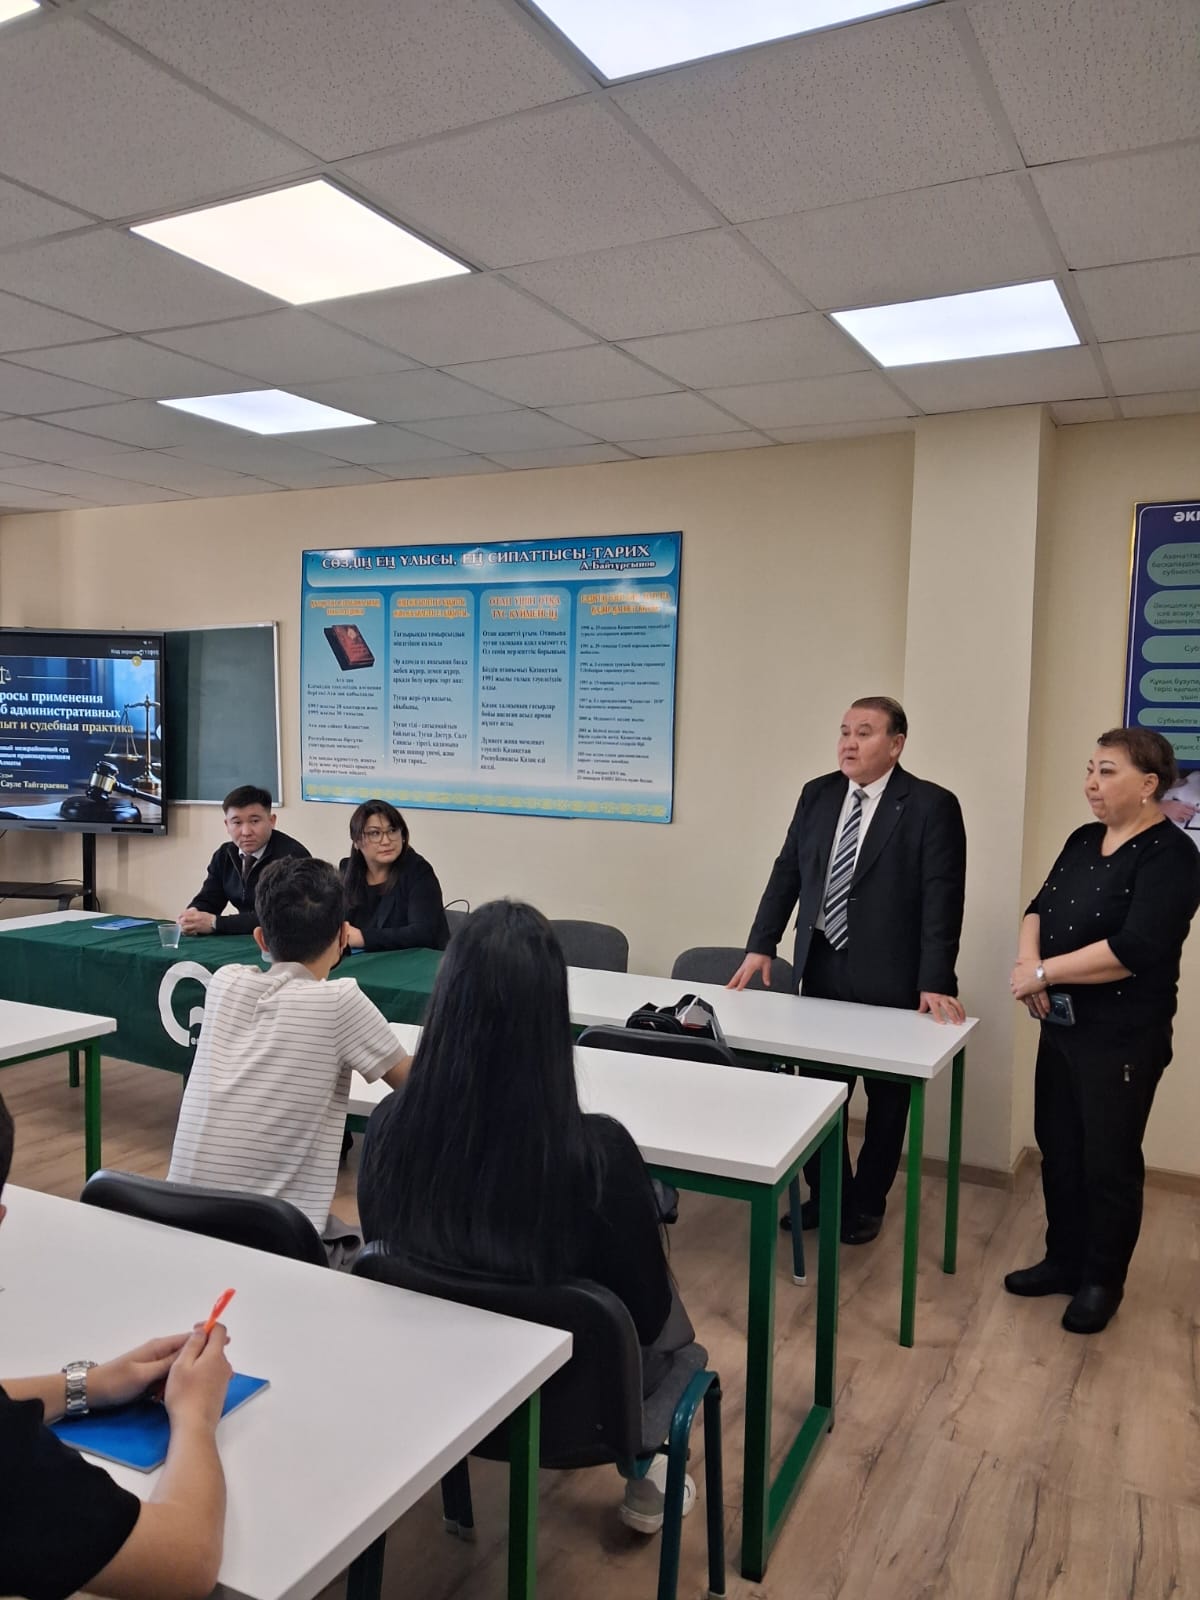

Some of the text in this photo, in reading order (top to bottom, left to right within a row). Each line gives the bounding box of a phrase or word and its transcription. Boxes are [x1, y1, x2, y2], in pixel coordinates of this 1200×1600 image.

[400, 554, 456, 566] ҰЛЫСЫ,
[488, 546, 650, 563] СИПАТТЫСЫ-ТАРИХ
[32, 693, 103, 704] применения
[10, 706, 121, 718] административных
[20, 722, 27, 730] и
[30, 721, 79, 734] судебная
[82, 723, 134, 734] практика
